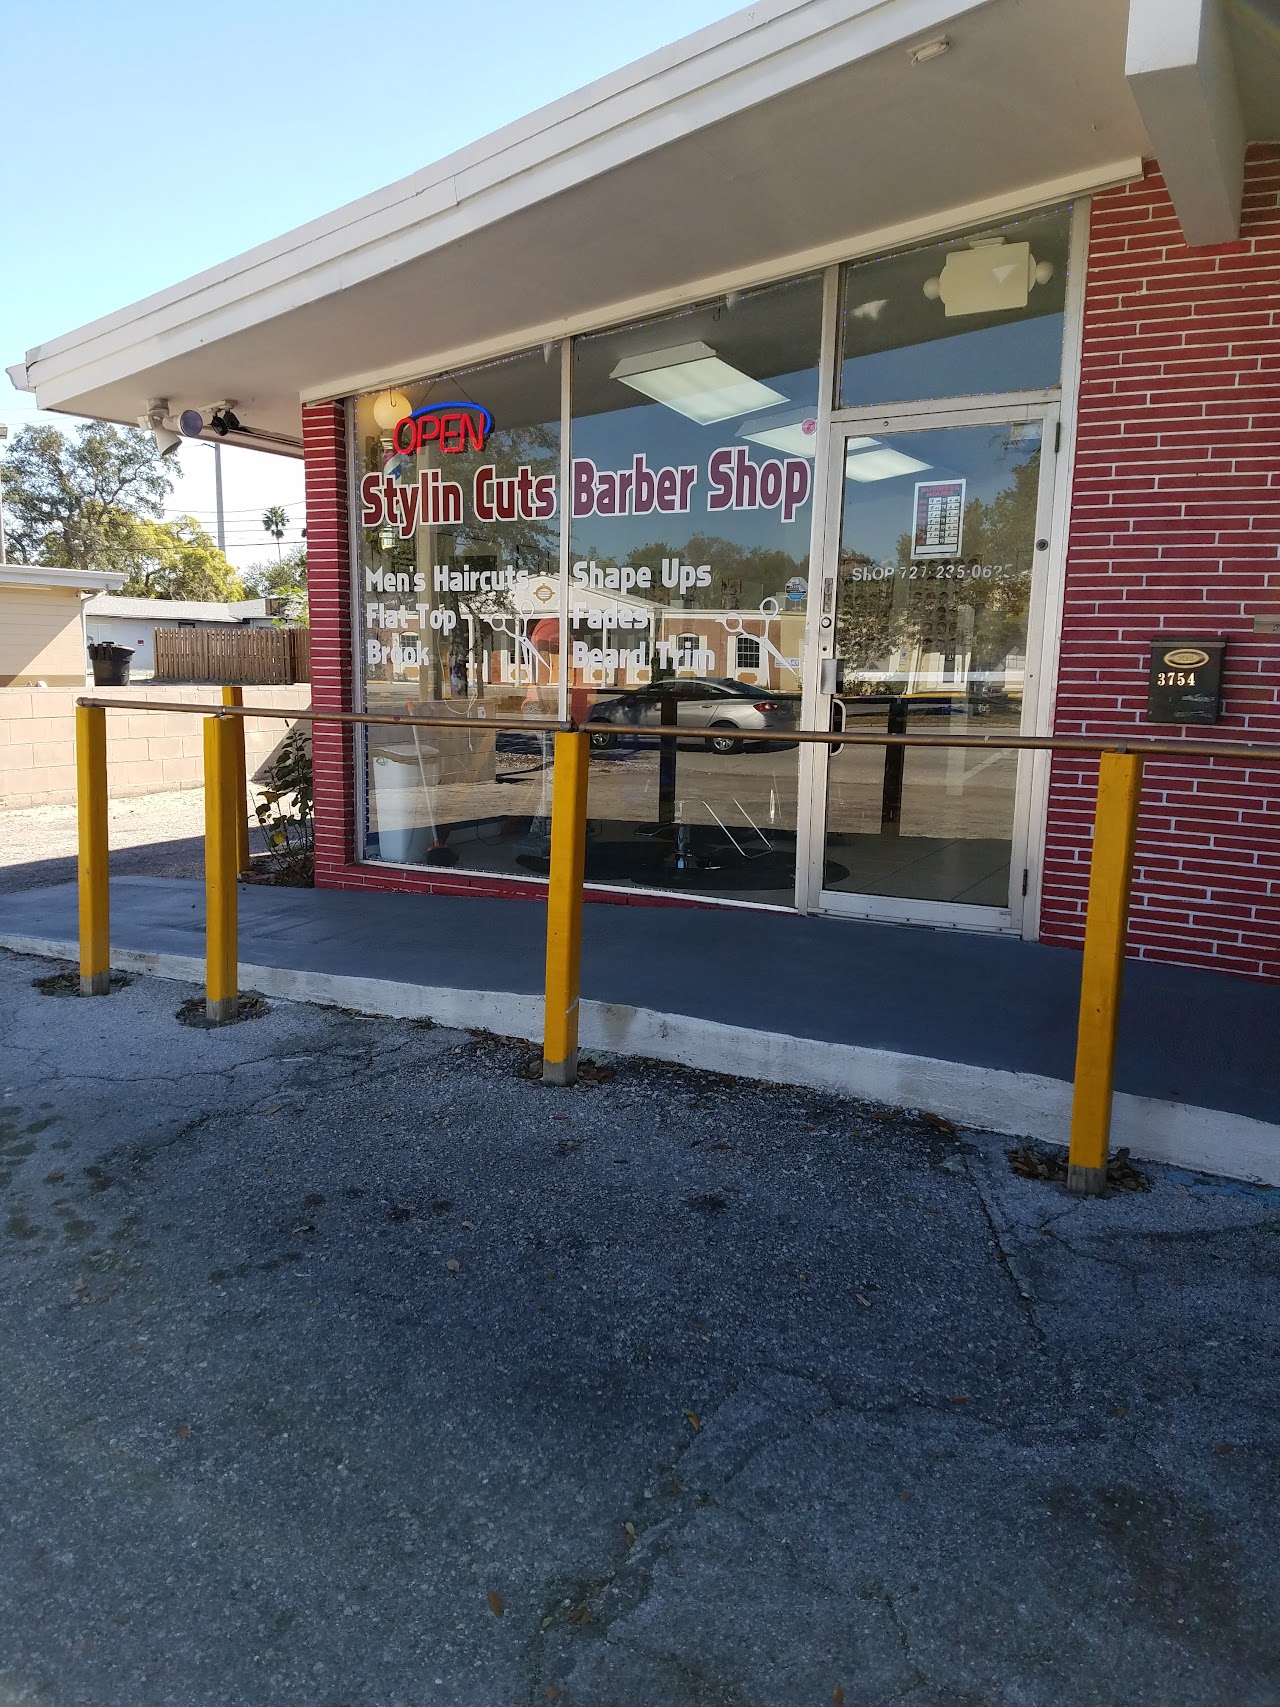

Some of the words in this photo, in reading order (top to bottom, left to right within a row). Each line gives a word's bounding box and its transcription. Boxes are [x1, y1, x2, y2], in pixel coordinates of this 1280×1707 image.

[393, 412, 485, 455] OPEN
[360, 468, 464, 540] Stylin
[473, 464, 557, 522] Cuts
[572, 453, 698, 519] Barber
[707, 445, 812, 523] Shop
[365, 565, 426, 593] Men's
[434, 564, 530, 593] Haircuts
[573, 559, 652, 595] Shape
[662, 558, 712, 595] Ups
[366, 602, 408, 630] Flat
[416, 602, 457, 636] Top
[573, 601, 648, 630] Fades
[367, 640, 430, 666] Brook
[573, 641, 646, 670] Beard
[656, 641, 715, 671] Trim
[1157, 672, 1196, 687] 3754
